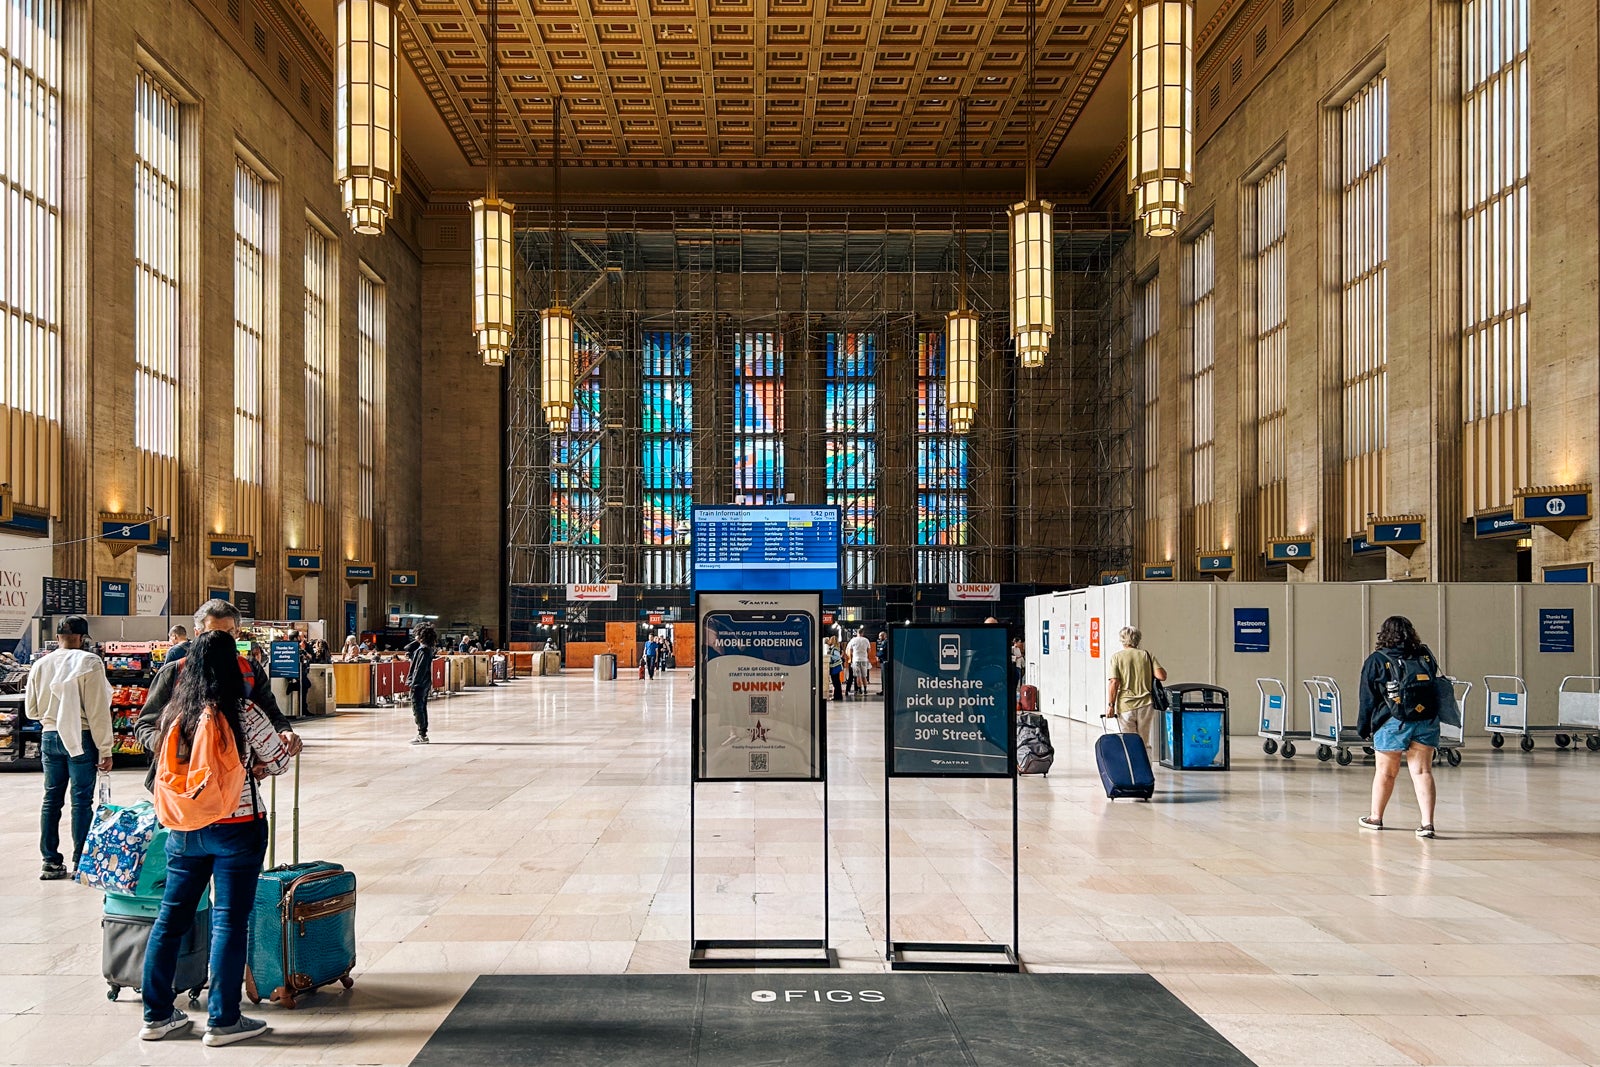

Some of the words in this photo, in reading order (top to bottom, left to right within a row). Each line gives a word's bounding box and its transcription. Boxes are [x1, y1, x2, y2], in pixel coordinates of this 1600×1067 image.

[122, 526, 130, 536] 8
[1394, 528, 1402, 538] 7
[299, 558, 309, 567] 10
[1213, 559, 1220, 567] 9
[956, 584, 992, 593] DUNKIN'
[715, 639, 751, 647] MOBILE
[753, 638, 802, 647] ORDERING
[732, 682, 785, 691] DUNKIN'
[917, 677, 983, 689] Rideshare
[906, 694, 933, 708] pick
[937, 696, 954, 708] up
[958, 694, 994, 708] point
[915, 711, 964, 723] located
[968, 714, 985, 723] on
[915, 728, 938, 740] 30th
[942, 729, 986, 740] Street.
[785, 990, 886, 1002] FIGS
